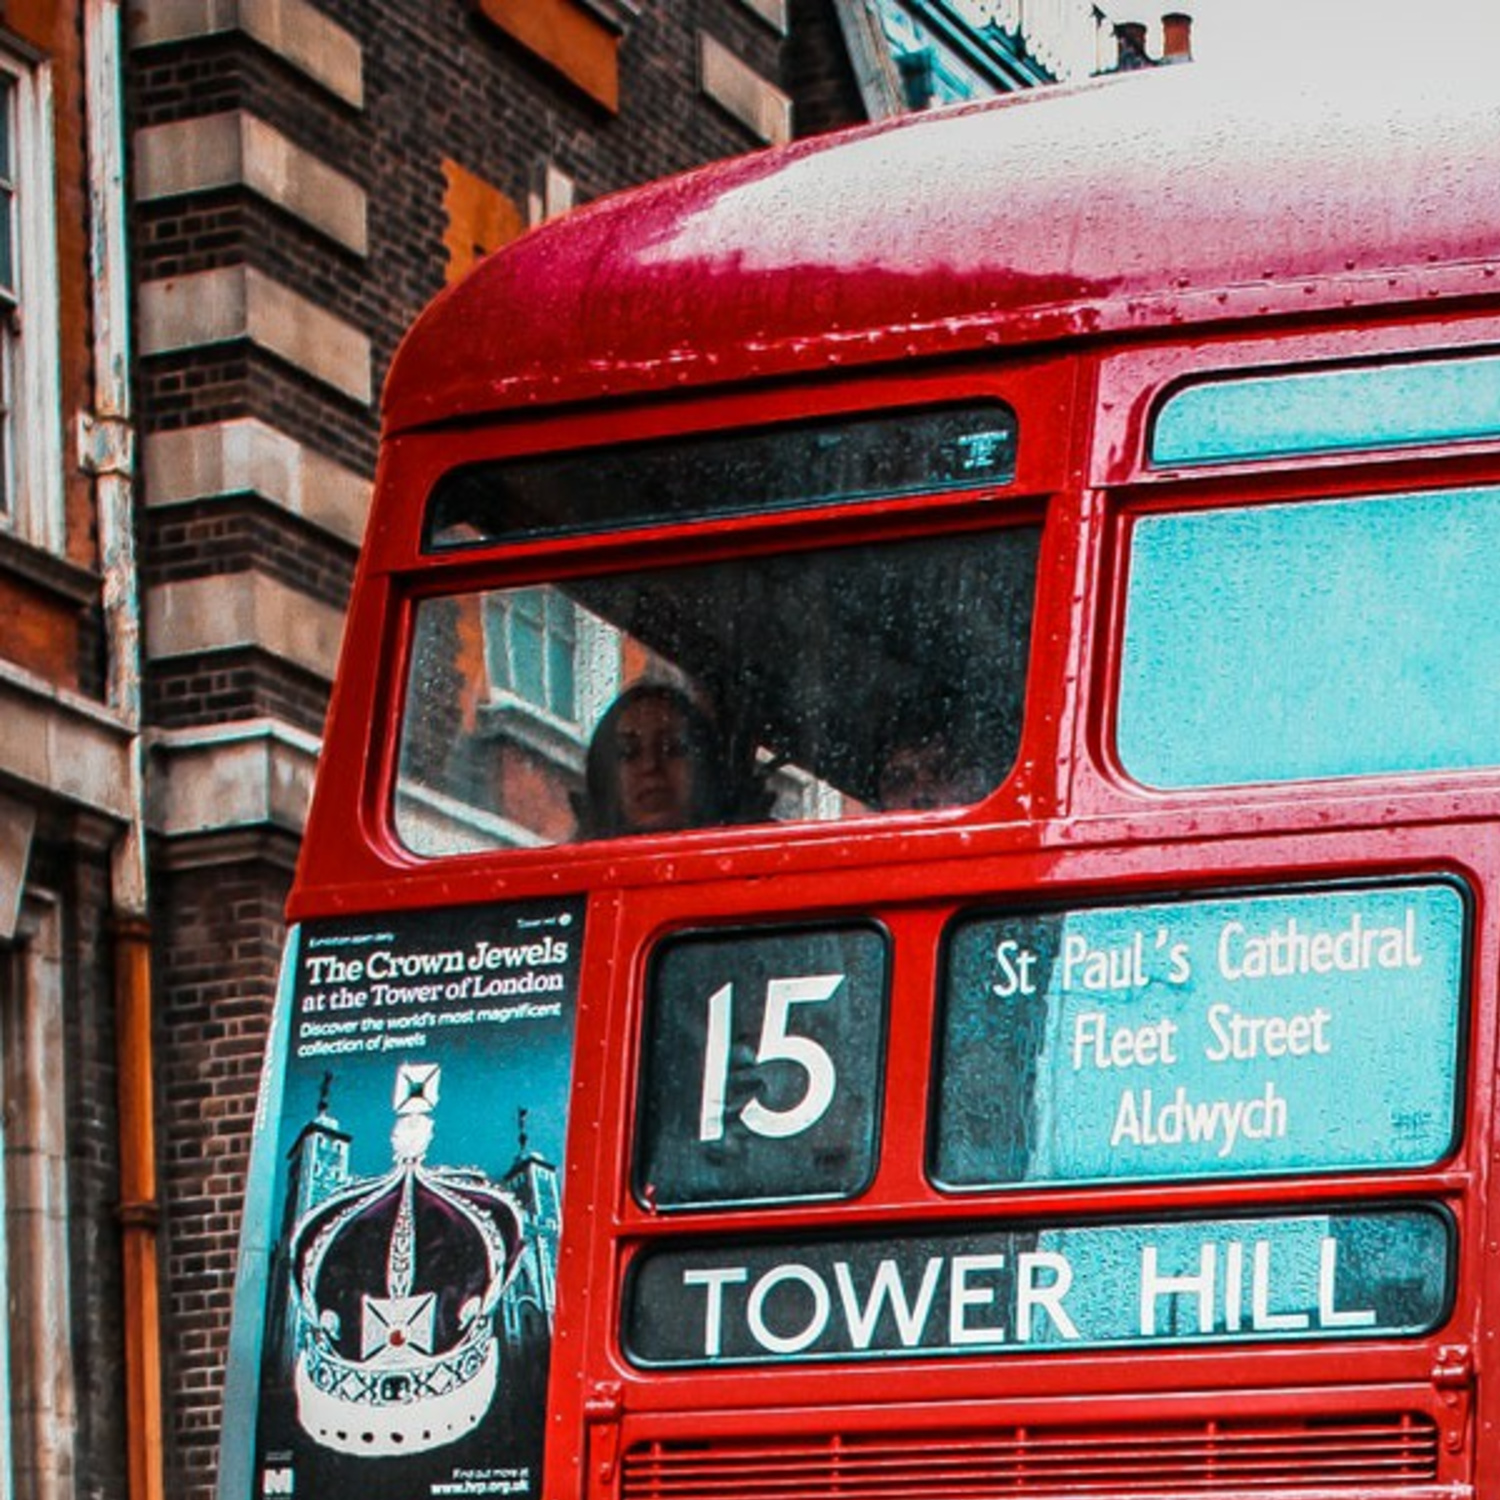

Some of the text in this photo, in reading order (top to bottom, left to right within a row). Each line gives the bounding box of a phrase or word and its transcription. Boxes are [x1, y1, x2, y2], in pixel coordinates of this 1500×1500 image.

[306, 936, 568, 985] The Crown Jewels
[991, 939, 1036, 998] St
[1218, 908, 1423, 981] Cathedral
[300, 1002, 561, 1038] Discover the world's most magnificent
[302, 971, 564, 1012] at the Tower of London
[298, 1033, 426, 1057] collection of jewels
[698, 973, 845, 1141] 15
[1070, 1002, 1331, 1071] Fleet Street
[1110, 1081, 1287, 1158] Aldwych
[683, 1236, 1376, 1355] TOWER HILL
